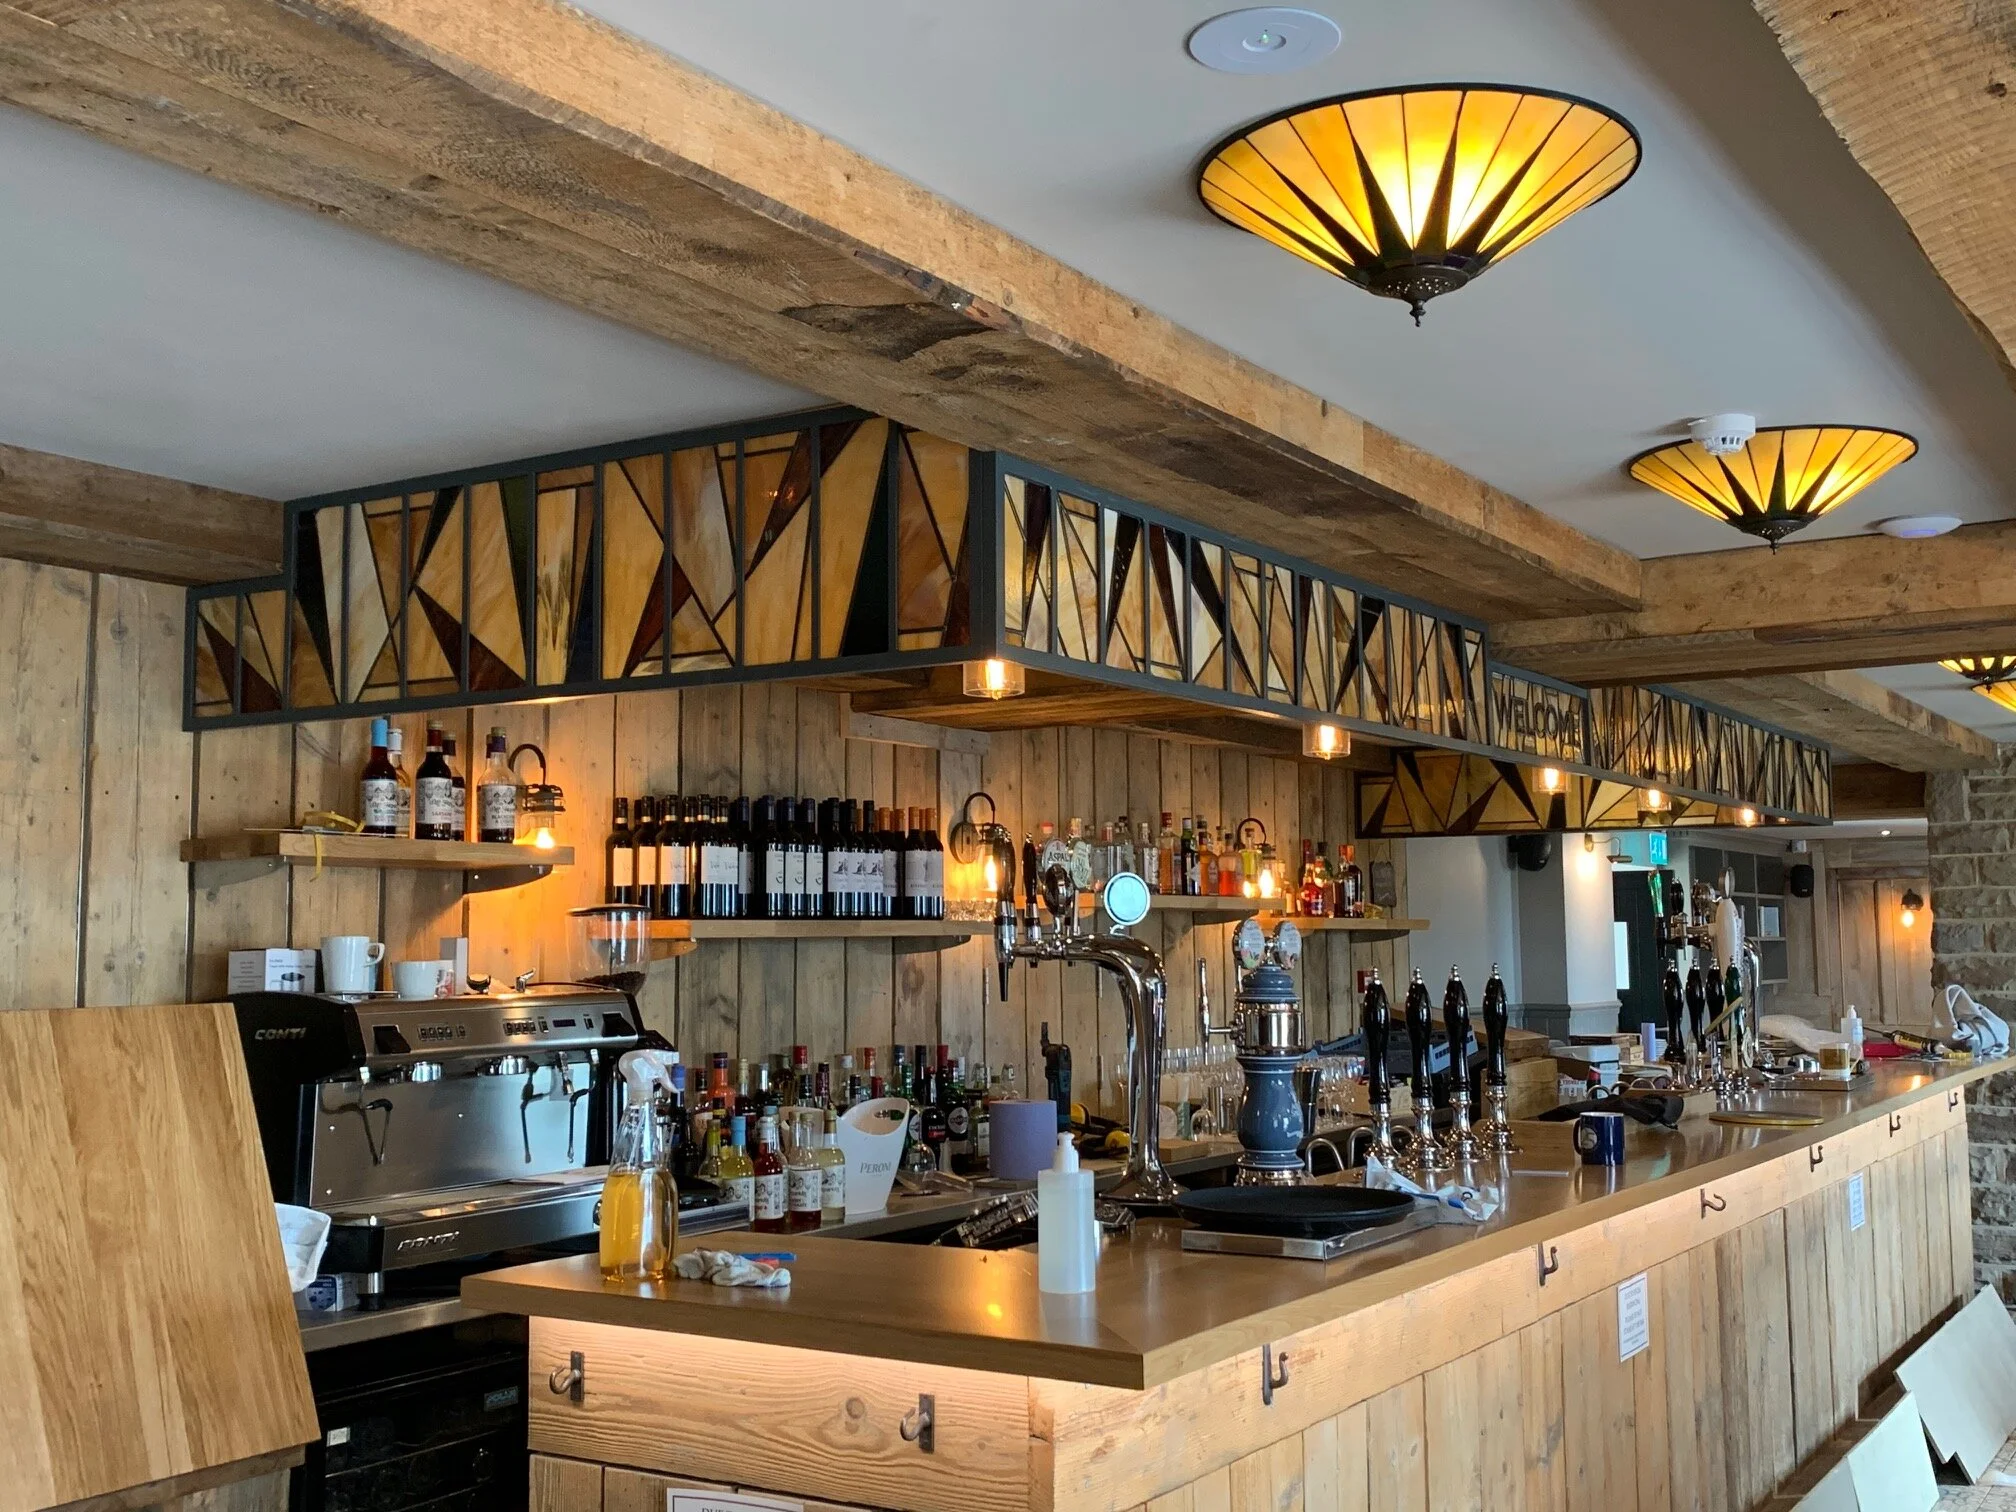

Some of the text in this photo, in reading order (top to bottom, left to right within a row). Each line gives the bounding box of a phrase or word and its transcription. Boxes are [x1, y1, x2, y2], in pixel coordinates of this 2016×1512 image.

[1492, 690, 1582, 747] WELCOME
[1047, 851, 1069, 864] ASPAL
[255, 1027, 307, 1041] CONTI
